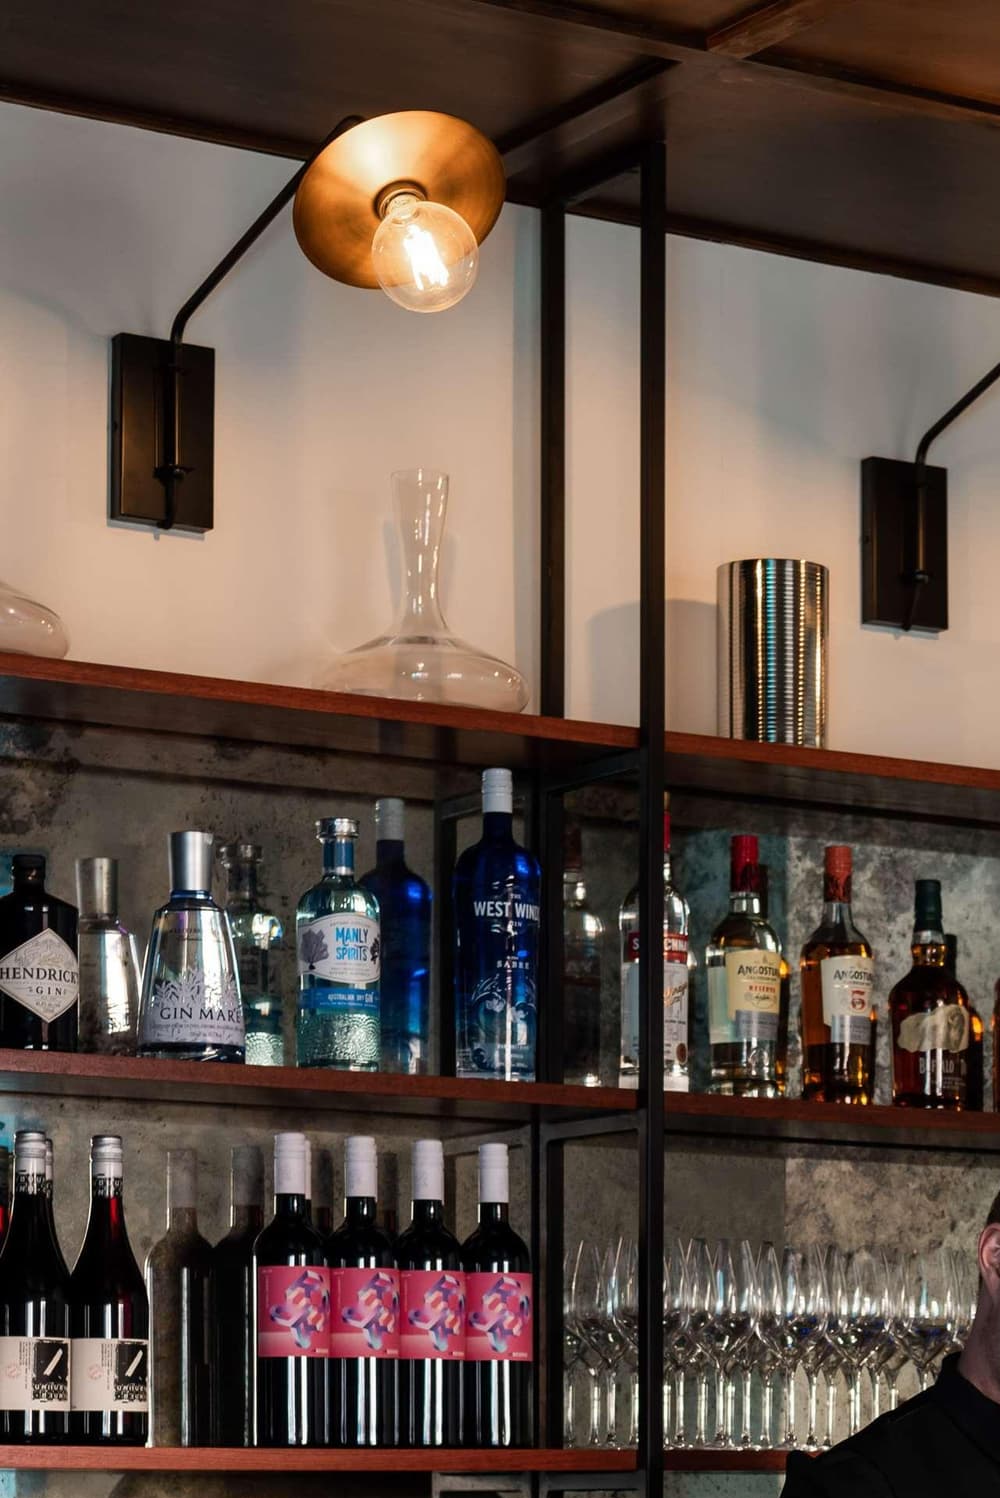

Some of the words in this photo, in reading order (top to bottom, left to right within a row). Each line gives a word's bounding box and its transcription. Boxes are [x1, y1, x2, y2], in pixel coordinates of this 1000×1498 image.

[473, 900, 511, 918] WEST
[335, 927, 369, 946] MANLY
[335, 945, 369, 961] SPIRITS
[35, 985, 62, 996] GIN
[160, 1007, 193, 1020] GIN
